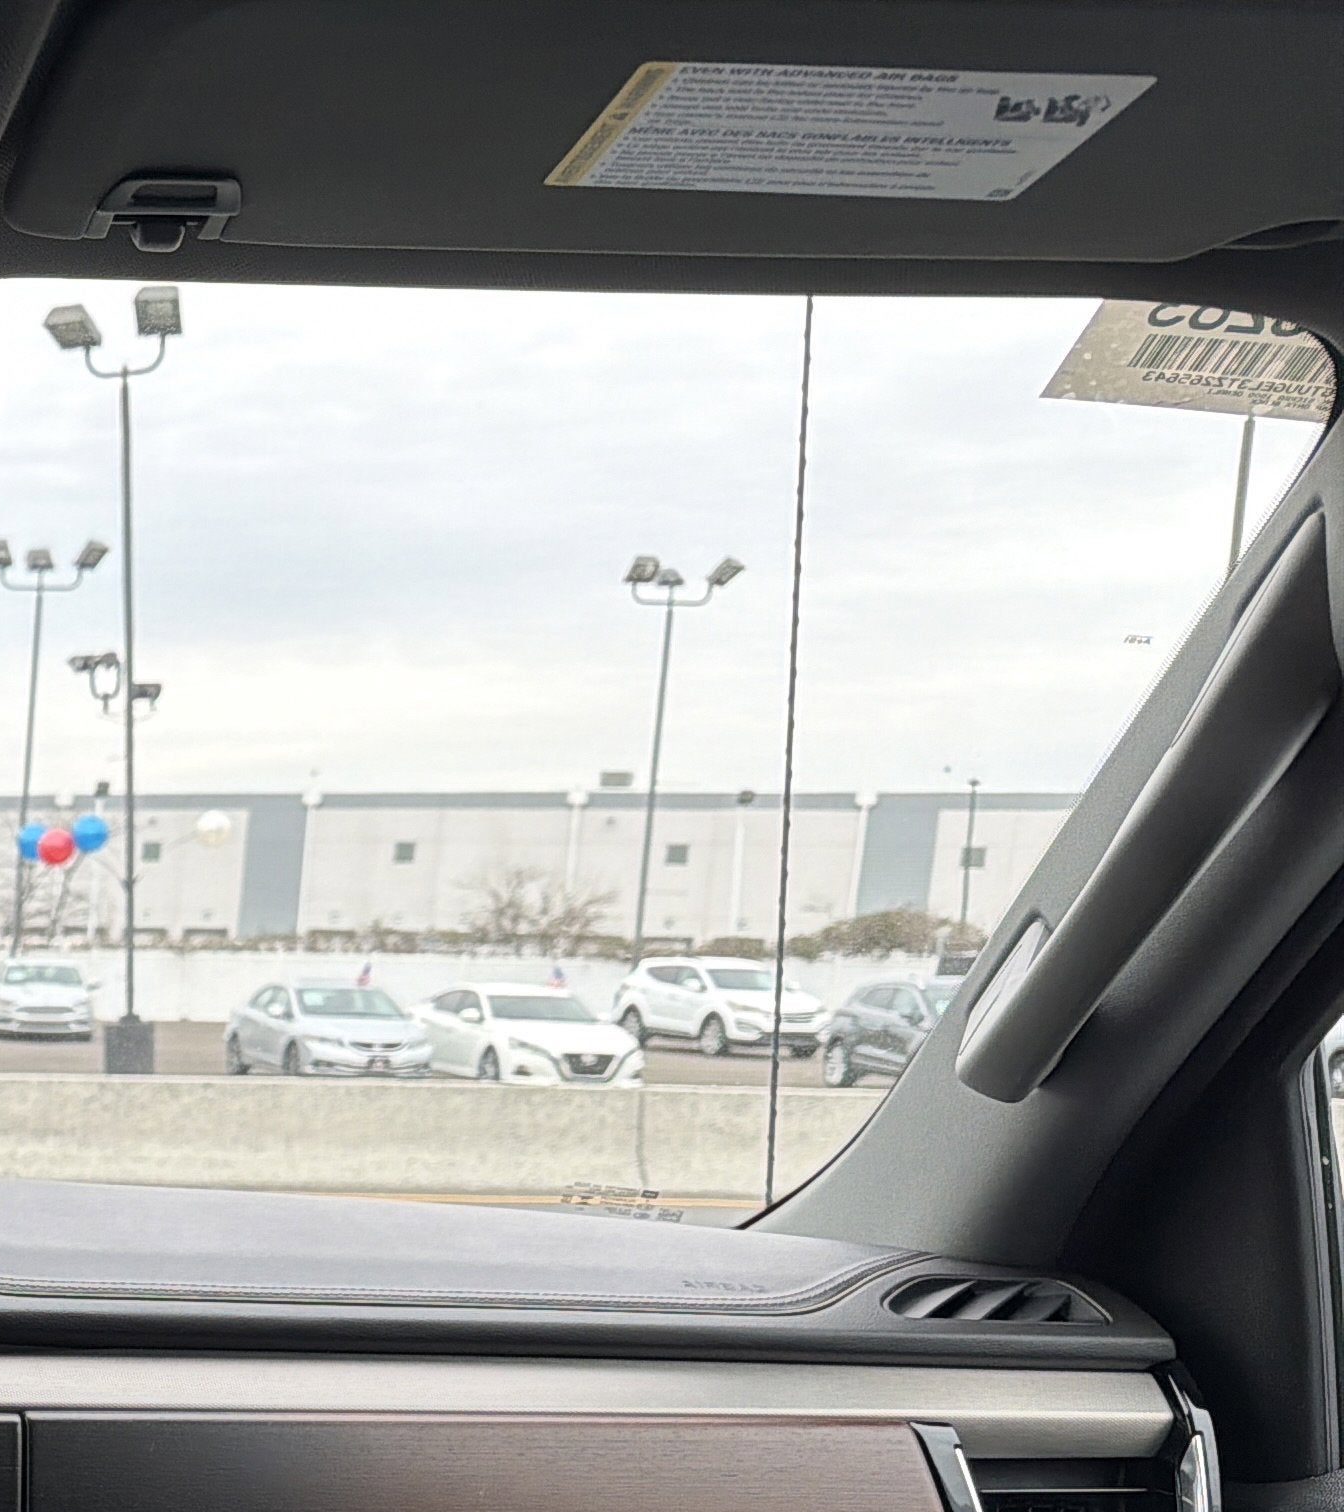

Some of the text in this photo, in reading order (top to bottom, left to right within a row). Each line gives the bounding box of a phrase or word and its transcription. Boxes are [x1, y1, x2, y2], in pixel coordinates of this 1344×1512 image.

[681, 66, 960, 82] EVEN WITH ADVANCED AIR BAGS
